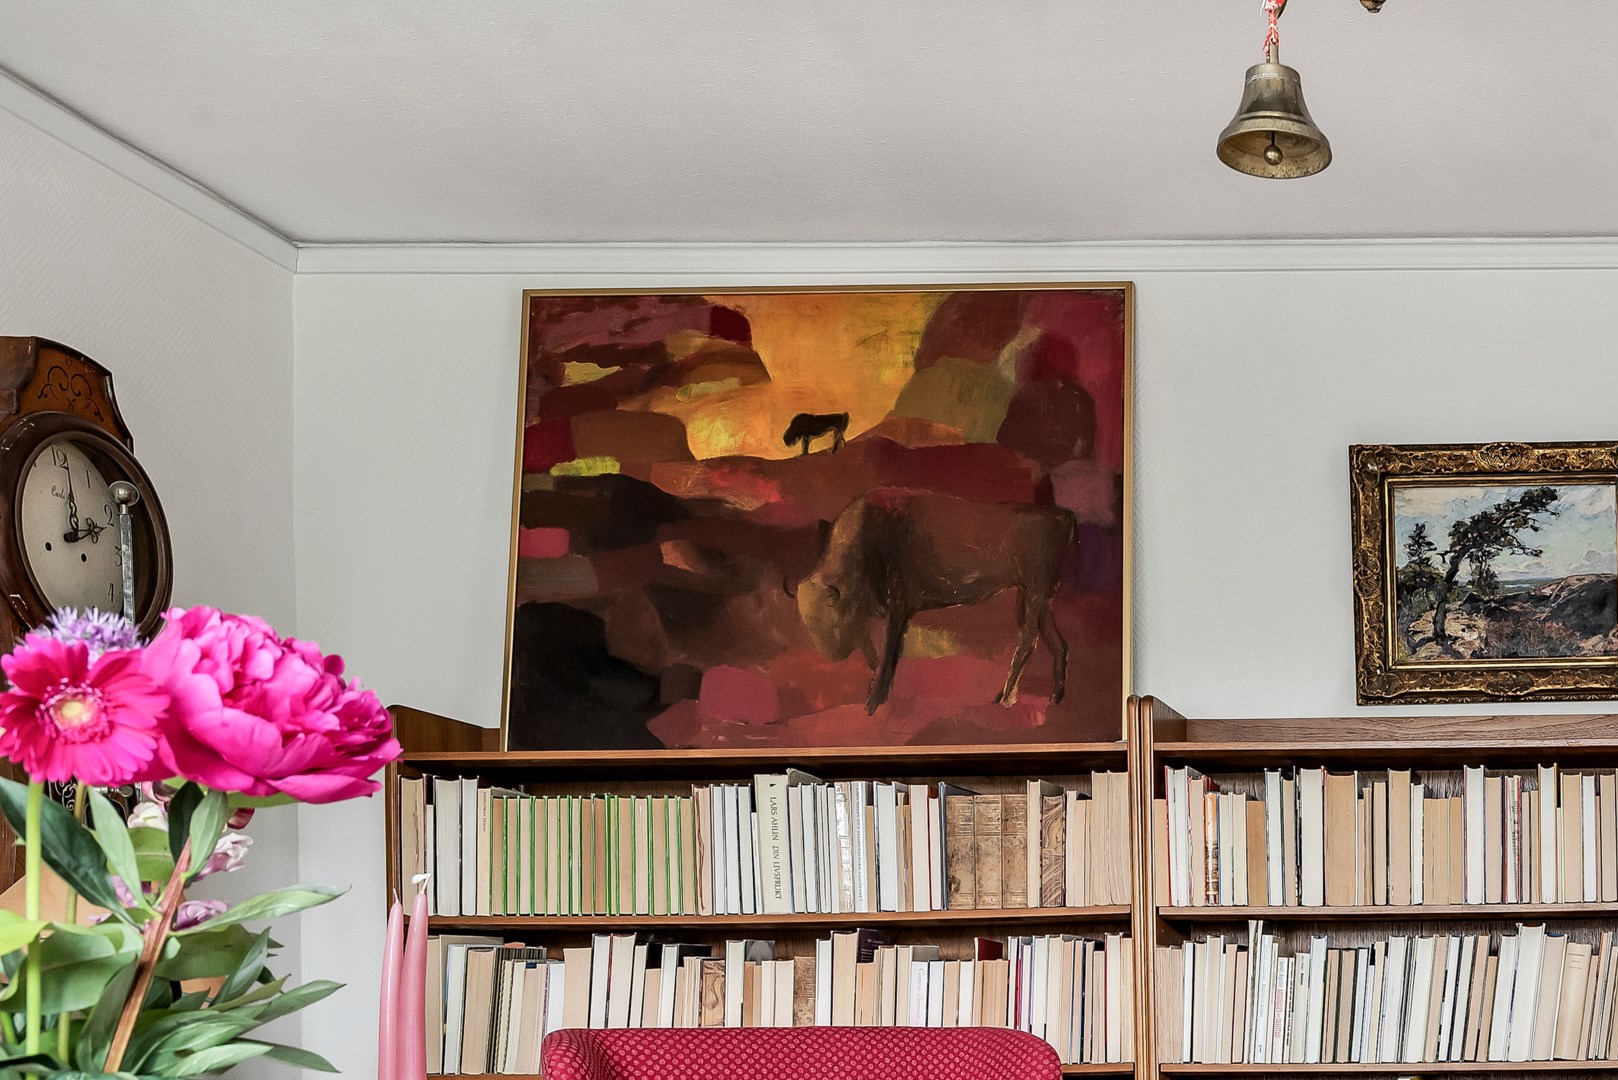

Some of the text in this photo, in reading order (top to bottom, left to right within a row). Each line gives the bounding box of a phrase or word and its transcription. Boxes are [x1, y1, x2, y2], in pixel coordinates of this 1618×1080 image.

[51, 447, 70, 470] 12
[104, 504, 114, 528] 2
[107, 582, 115, 603] 4
[771, 817, 779, 841] AHLIN
[772, 846, 780, 859] DIN
[774, 862, 782, 900] LIVSFRUKT
